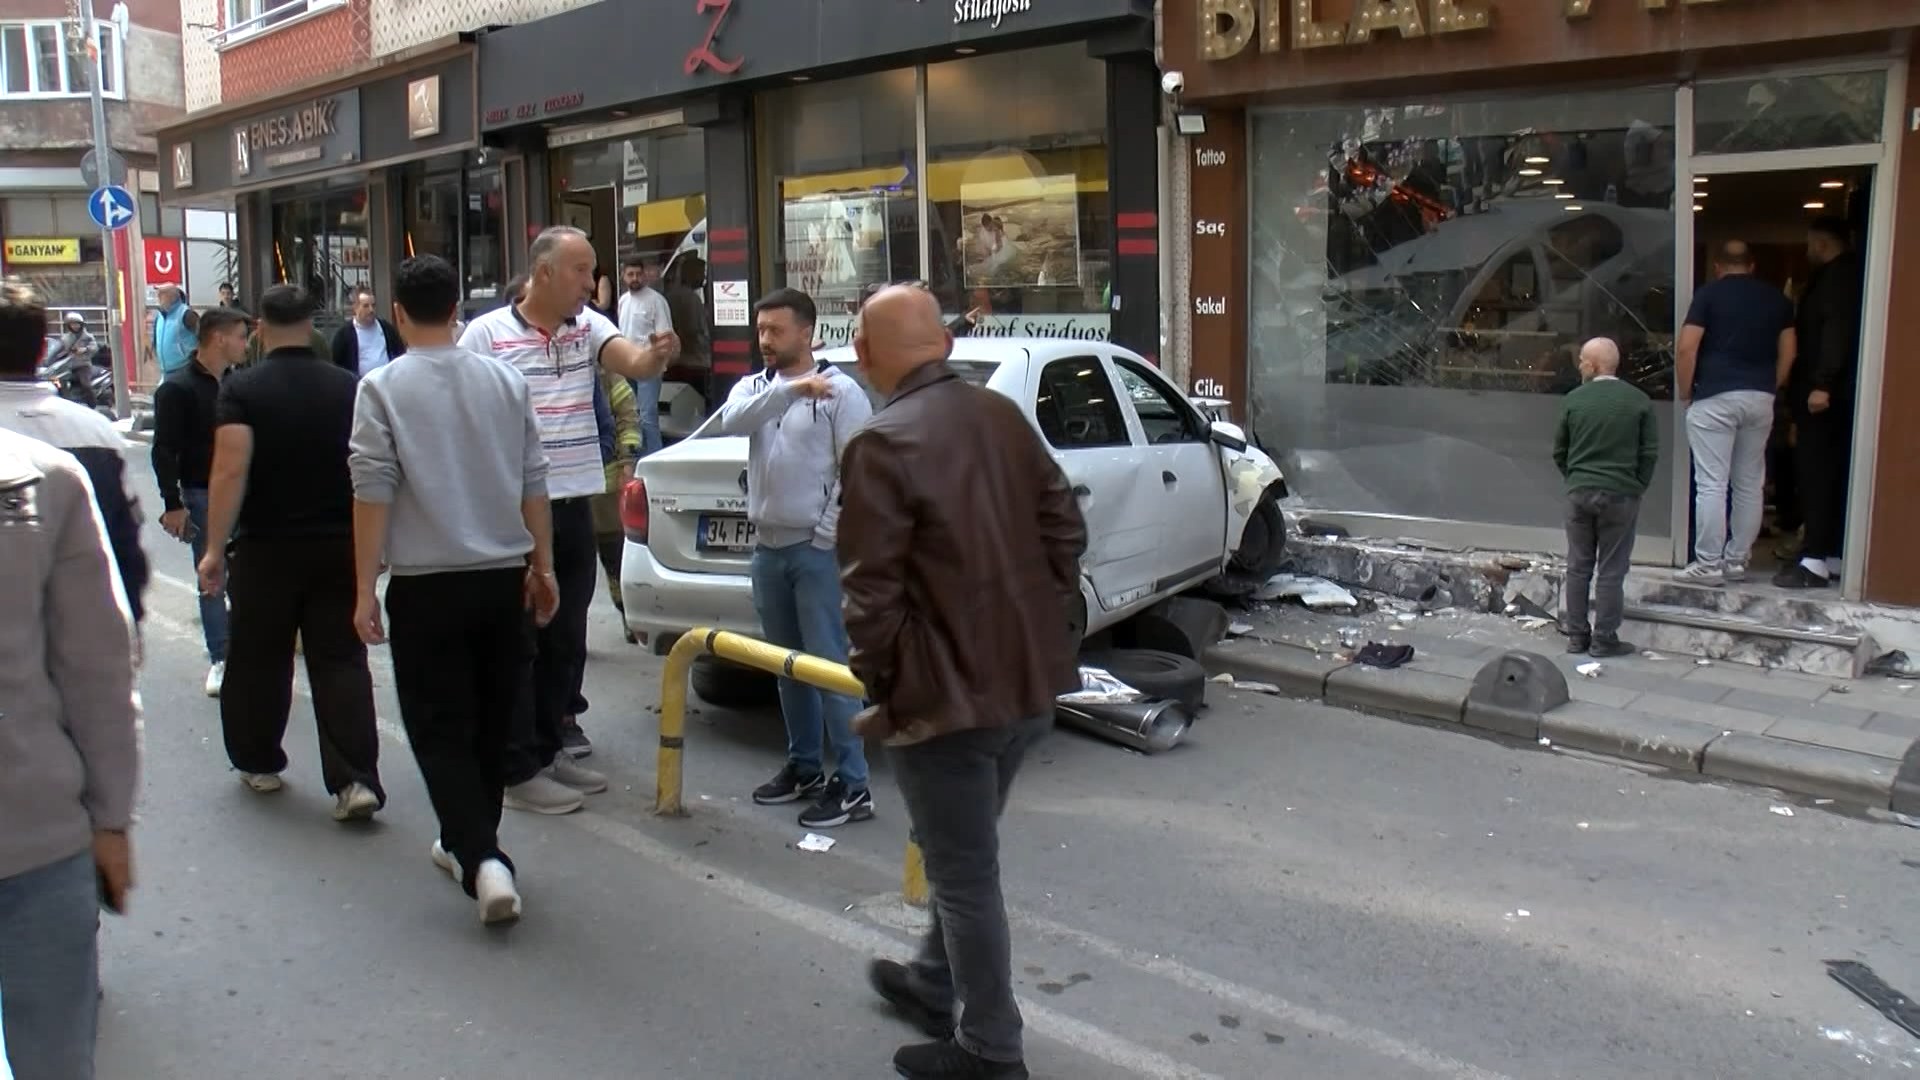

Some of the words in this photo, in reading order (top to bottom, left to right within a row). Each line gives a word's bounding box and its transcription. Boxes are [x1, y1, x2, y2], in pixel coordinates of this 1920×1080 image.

[1196, 147, 1226, 167] Tattoo
[1196, 220, 1226, 237] Saç
[1196, 296, 1226, 315] Sakal
[820, 319, 858, 347] Prof
[1194, 378, 1224, 397] Cila
[716, 499, 747, 508] SYM
[708, 520, 727, 543] 34
